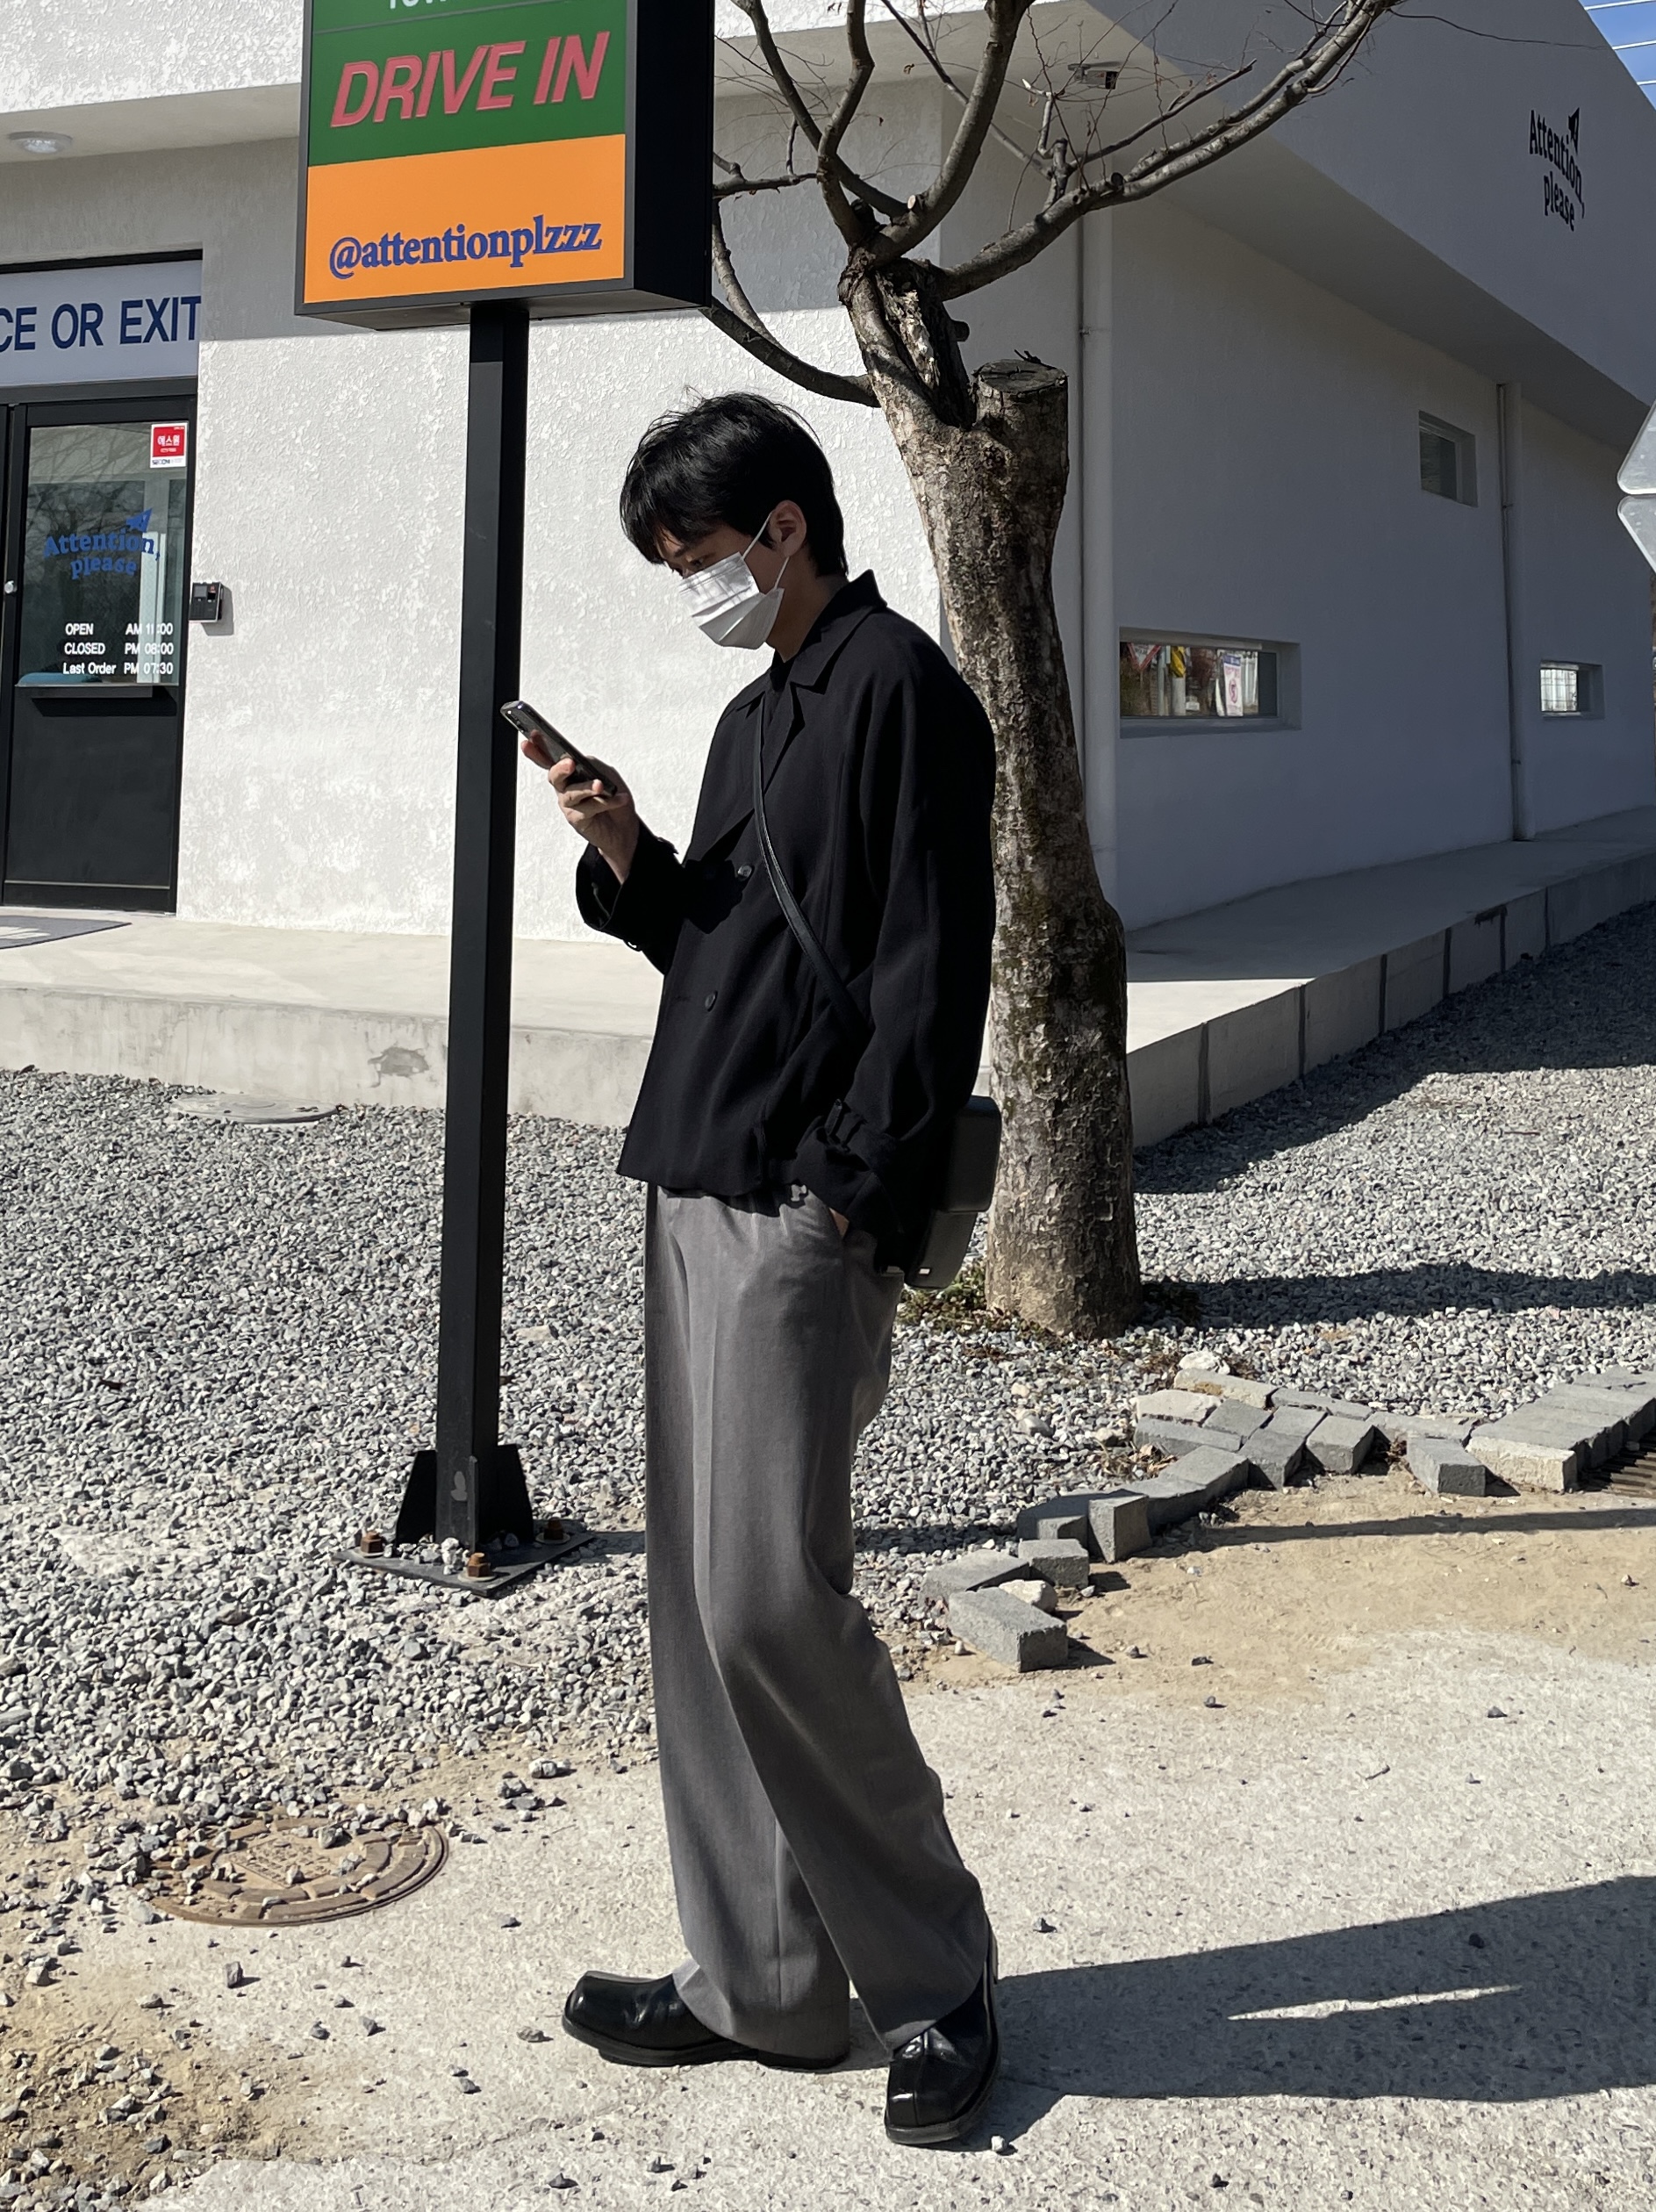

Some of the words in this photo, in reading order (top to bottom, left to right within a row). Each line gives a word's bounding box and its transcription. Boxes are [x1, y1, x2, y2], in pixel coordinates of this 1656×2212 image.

[330, 40, 526, 128] DRIVE
[533, 31, 611, 105] IN
[1543, 170, 1575, 232] please
[329, 214, 603, 280] @attentionplzzz
[51, 302, 104, 349] OR
[119, 295, 202, 345] EXIT
[43, 528, 161, 561] Attention,
[70, 556, 137, 580] please
[65, 622, 94, 636] OPEN
[125, 622, 141, 636] AM
[64, 642, 106, 655] CLOSED
[124, 642, 140, 655] PM
[144, 642, 174, 655] 08:00
[62, 662, 85, 675] Last
[87, 661, 117, 675] Order
[124, 662, 140, 675] PM
[143, 662, 174, 675] 07:30
